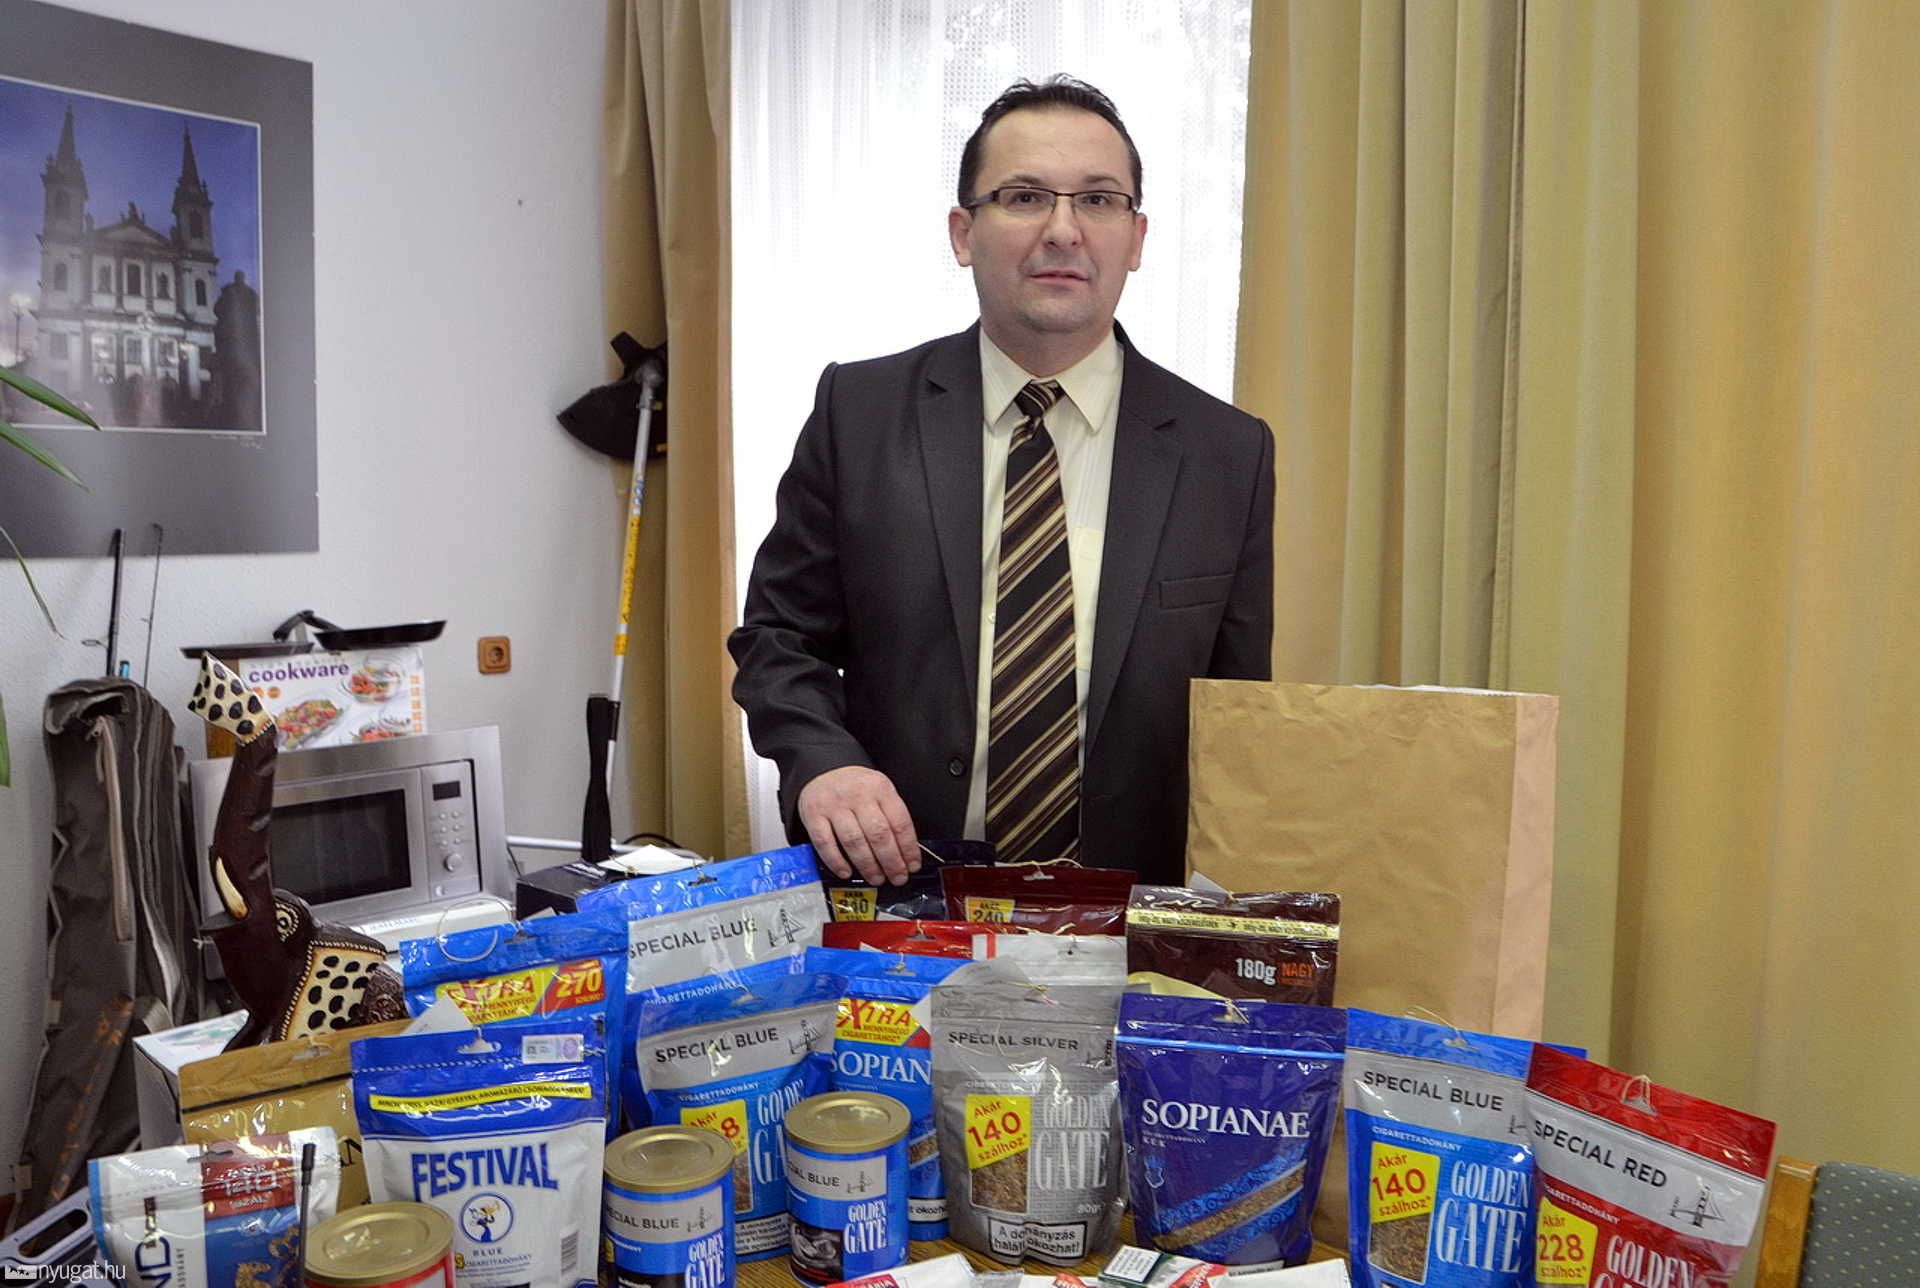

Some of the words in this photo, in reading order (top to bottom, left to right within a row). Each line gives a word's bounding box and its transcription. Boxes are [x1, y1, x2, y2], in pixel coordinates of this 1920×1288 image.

[249, 662, 350, 684] cookware
[629, 931, 706, 960] SPECIAL
[709, 918, 758, 942] BLUE
[556, 968, 603, 999] 270
[1236, 958, 1277, 986] 180g
[655, 1038, 732, 1064] SPECIAL
[736, 1027, 779, 1048] BLUE
[948, 1031, 1018, 1046] SPECIAL
[1023, 1035, 1079, 1051] SILVER
[1363, 1071, 1443, 1100] SPECIAL
[1450, 1087, 1504, 1112] BLUE
[975, 1101, 1002, 1119] Akár
[1141, 1098, 1311, 1138] SOPIANAE
[968, 1111, 1022, 1148] 140
[1035, 1130, 1111, 1191] GATE
[1377, 1153, 1408, 1170] Akár
[1534, 1119, 1616, 1169] SPECIAL
[1622, 1157, 1668, 1188] RED
[411, 1142, 560, 1203] FESTIVAL
[807, 1171, 841, 1188] BLUE
[1371, 1168, 1427, 1201] 140
[1451, 1159, 1532, 1208] GOLDEN
[642, 1217, 680, 1230] BLUE
[847, 1199, 887, 1223] GOLDEN
[688, 1231, 724, 1263] GOLDEN
[843, 1216, 887, 1255] GATE
[999, 1225, 1009, 1239] A
[1435, 1197, 1528, 1273] GATE
[1536, 1233, 1585, 1262] 228
[685, 1251, 726, 1288] GATE
[1607, 1234, 1697, 1288] GOLDEN
